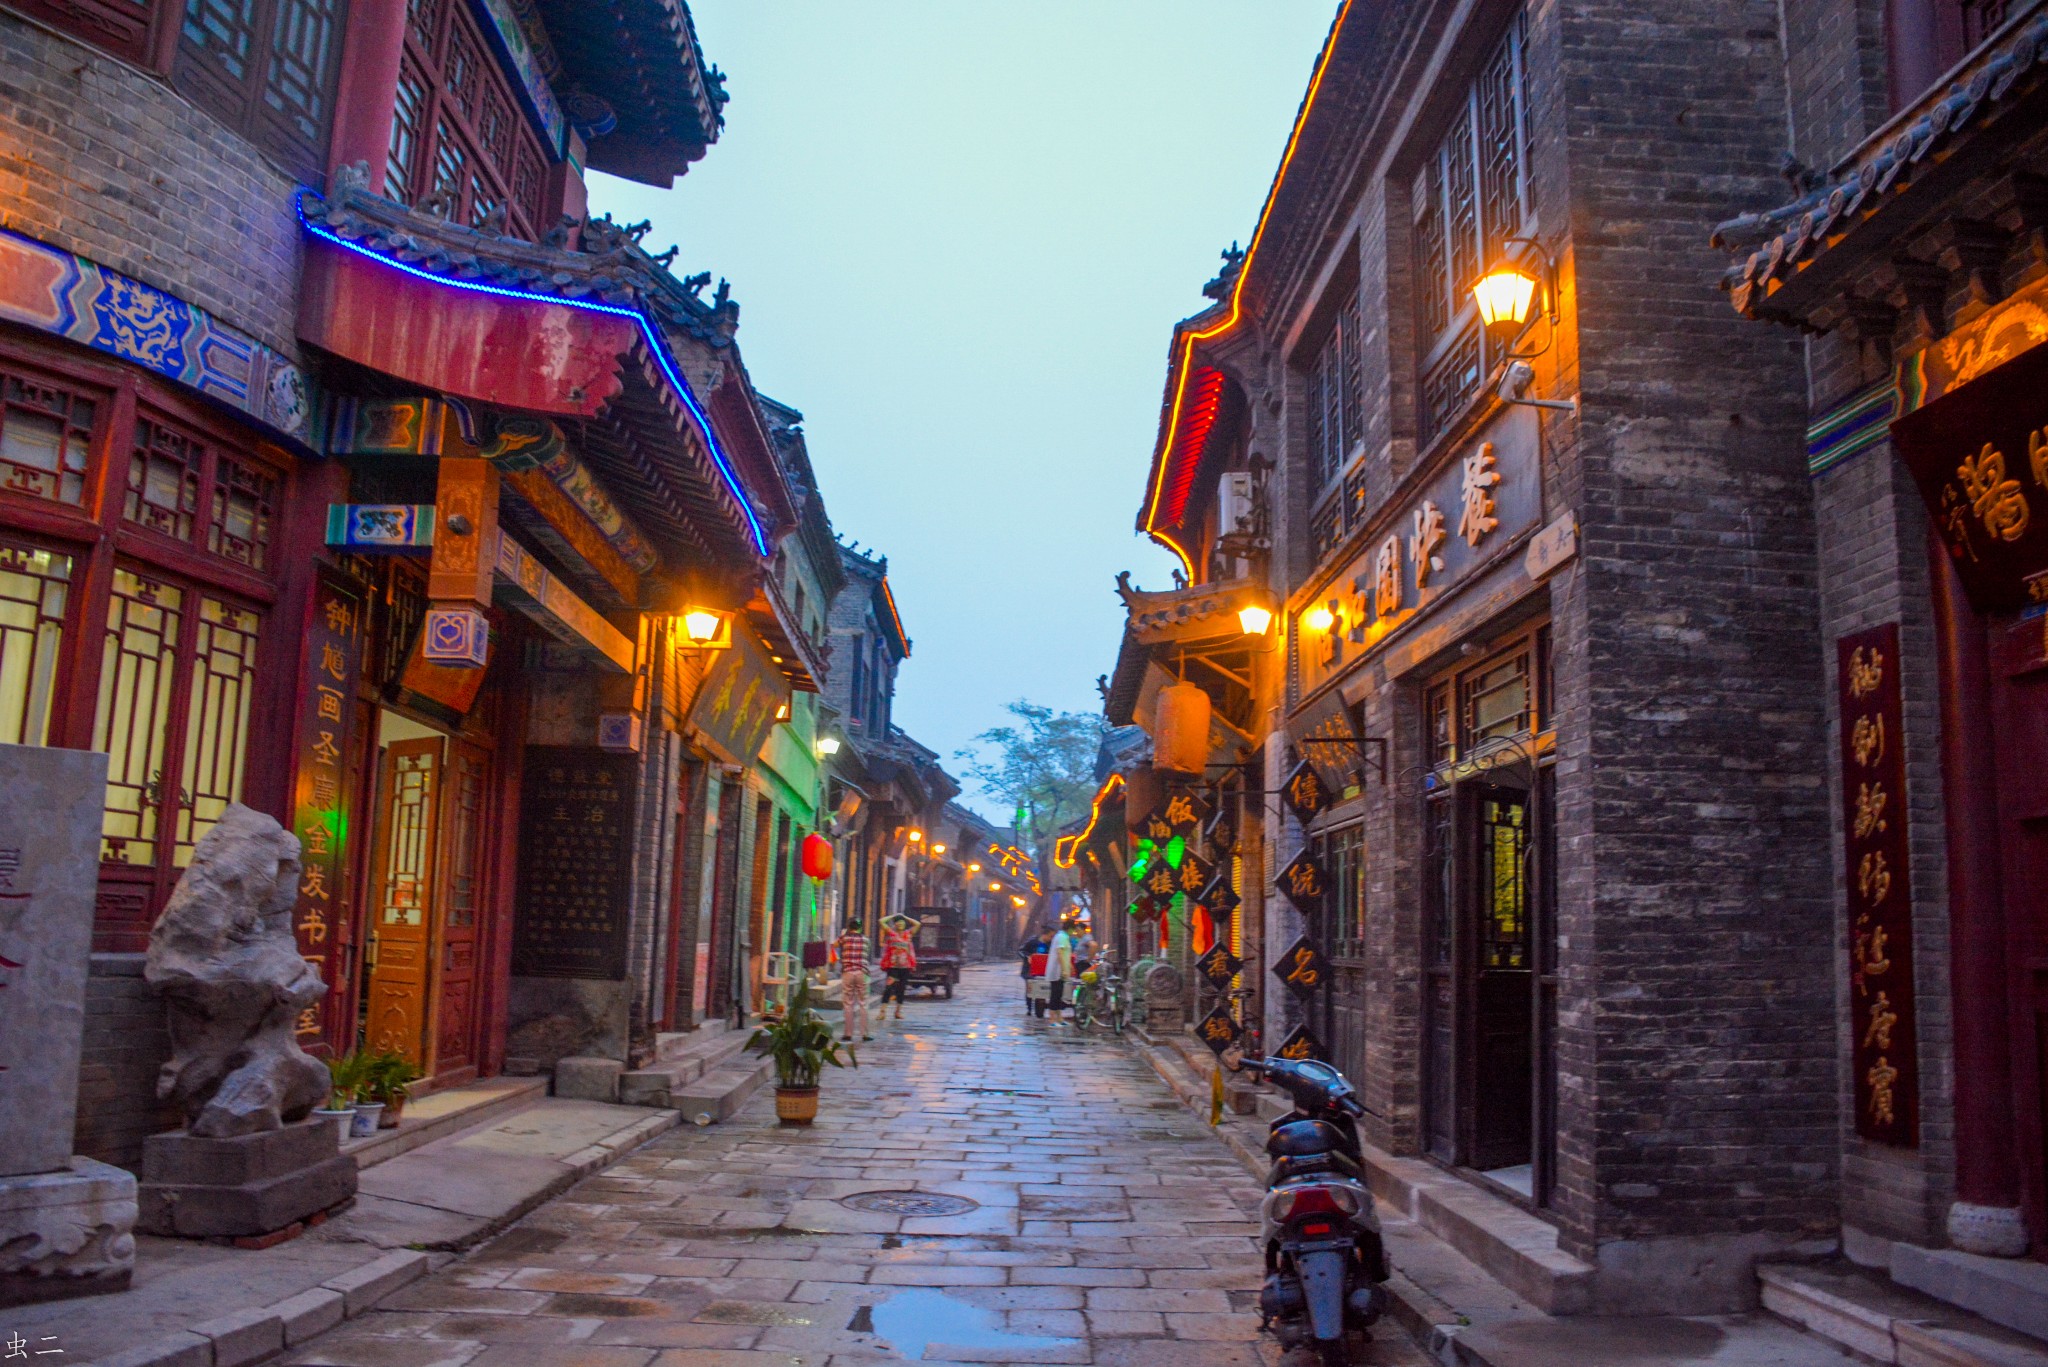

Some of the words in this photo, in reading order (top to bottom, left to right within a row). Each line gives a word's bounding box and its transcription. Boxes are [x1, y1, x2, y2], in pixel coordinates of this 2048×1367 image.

[293, 598, 352, 1035] 钟馗画圣廉金发书室
